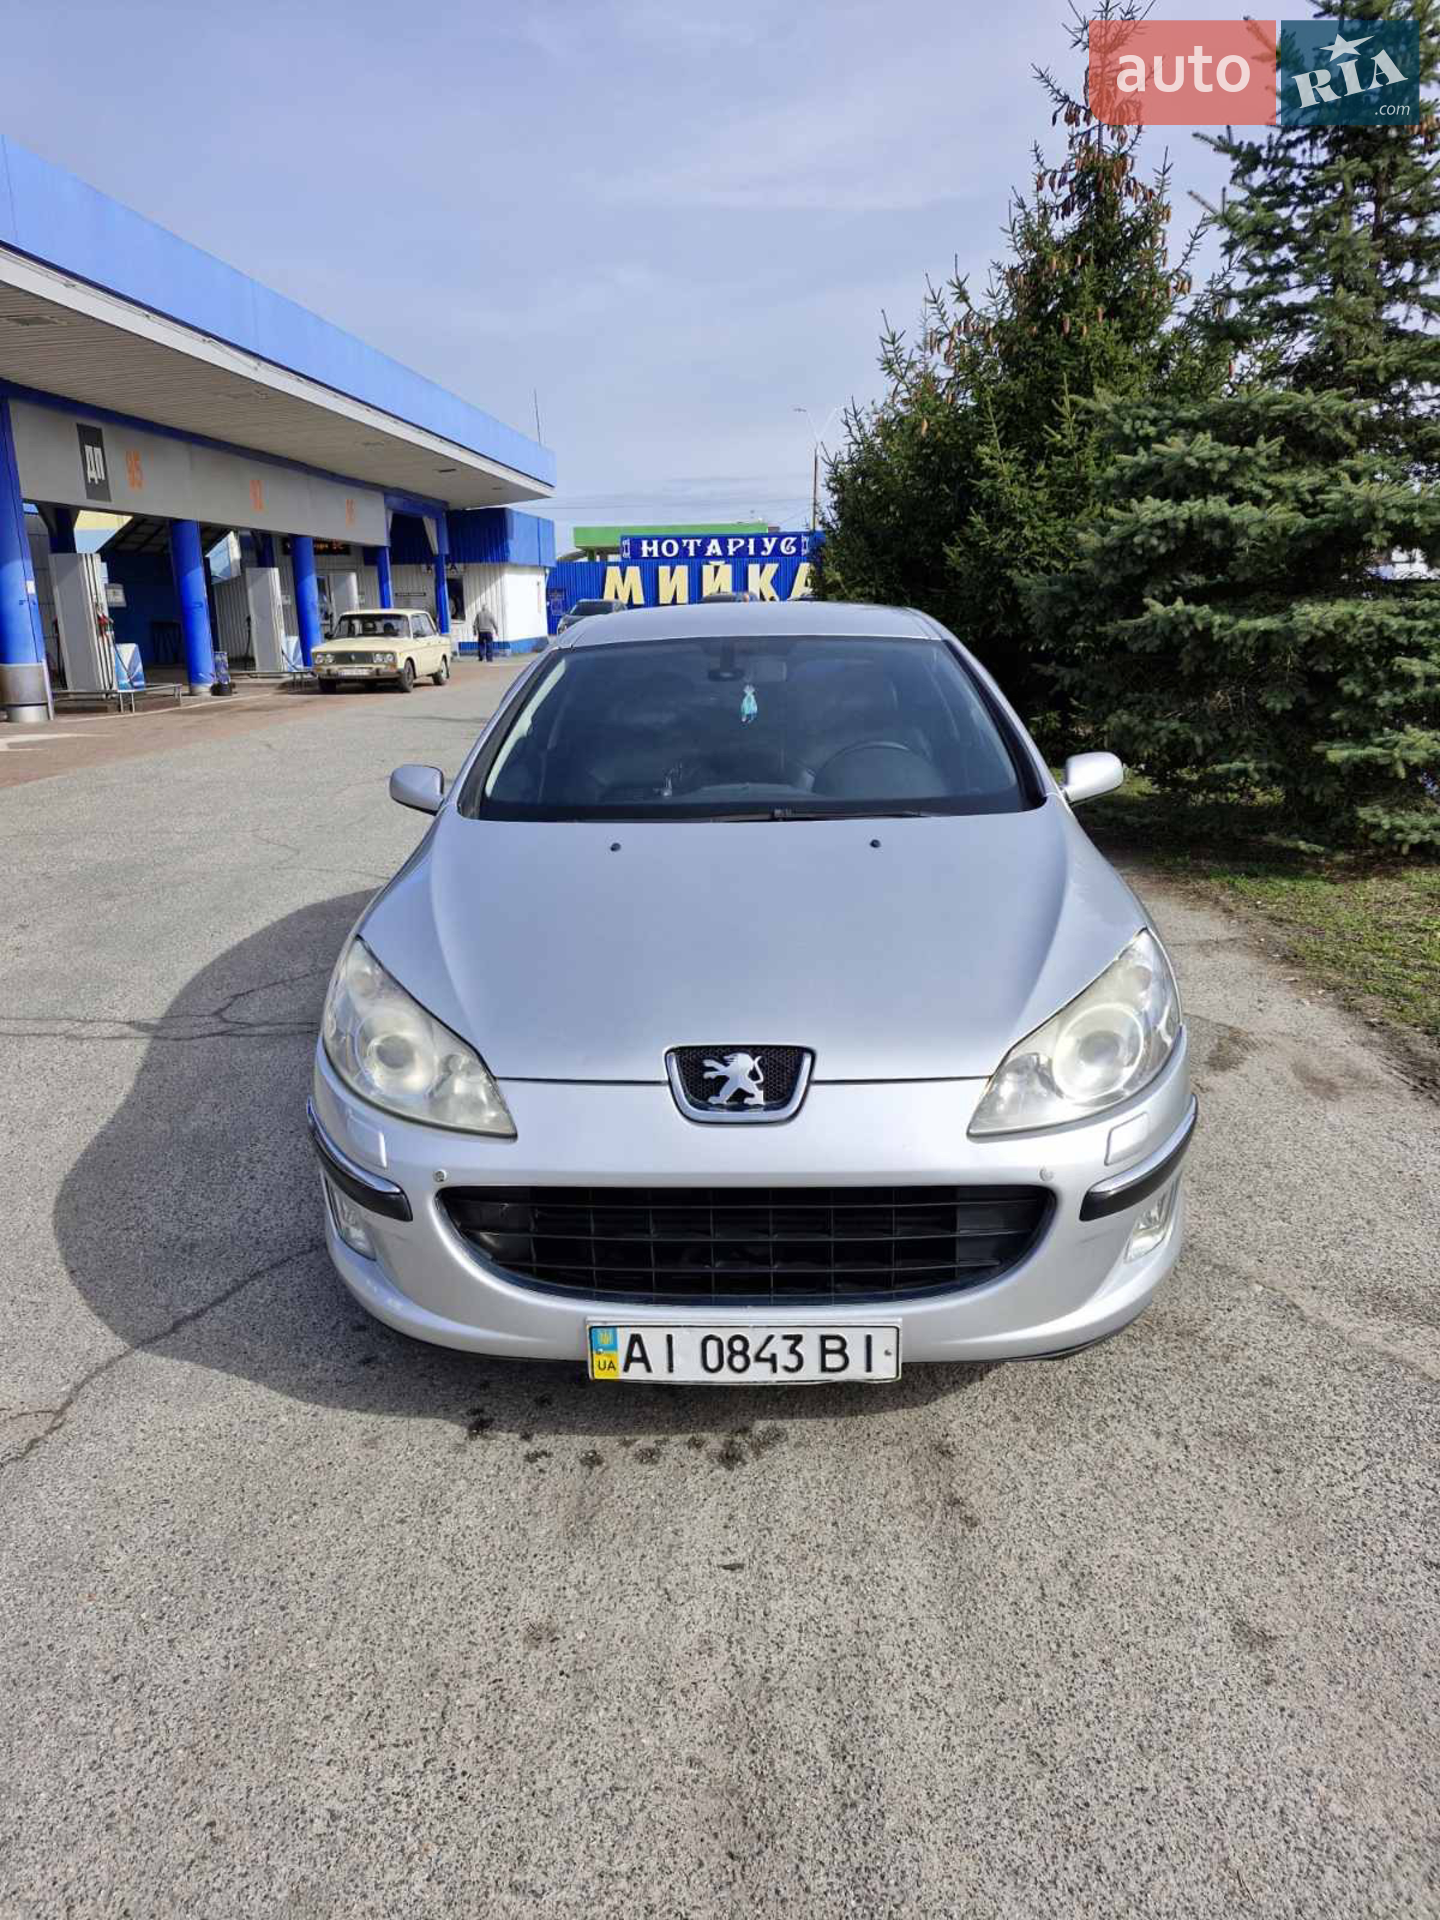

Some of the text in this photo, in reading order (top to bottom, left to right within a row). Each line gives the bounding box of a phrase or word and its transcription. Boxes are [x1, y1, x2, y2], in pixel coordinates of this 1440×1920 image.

[640, 536, 798, 558] НОТАРІУС
[623, 1333, 872, 1374] AI 0843 BI
[598, 1360, 616, 1372] UA
